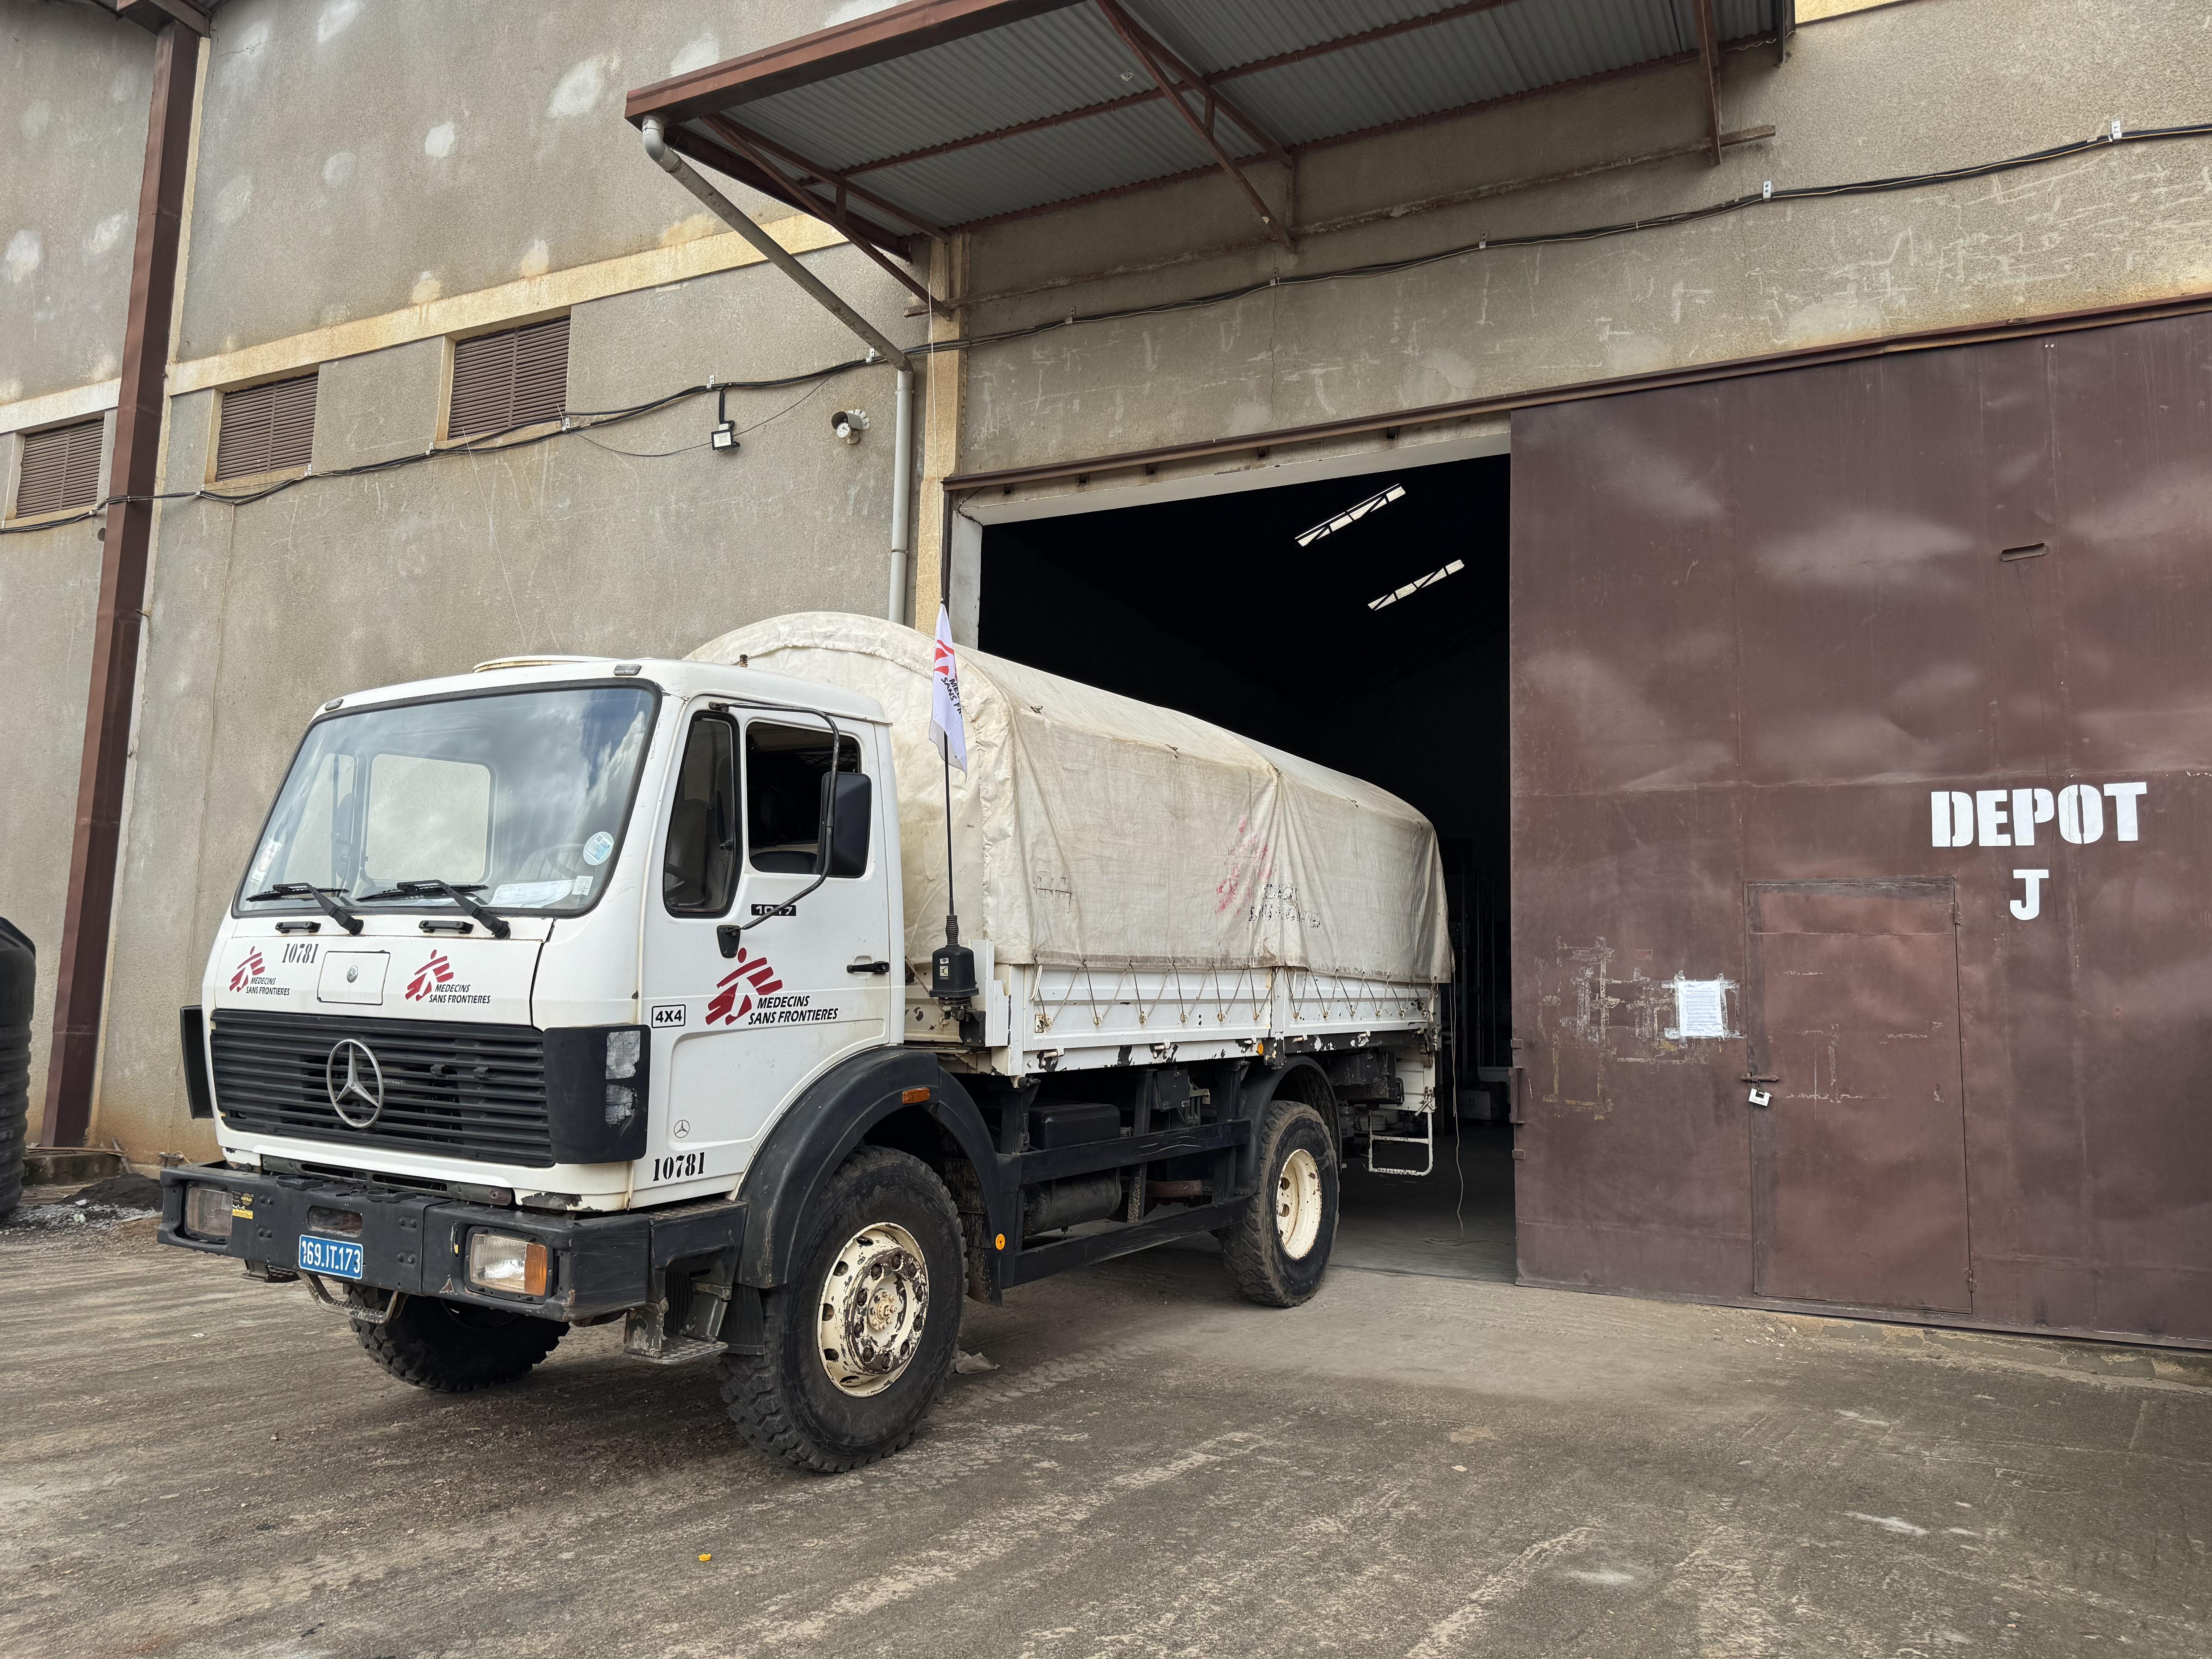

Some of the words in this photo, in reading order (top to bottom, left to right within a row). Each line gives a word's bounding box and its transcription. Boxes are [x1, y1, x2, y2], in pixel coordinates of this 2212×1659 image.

[941, 677, 957, 701] SANS
[1931, 782, 2147, 847] DEPOT
[2010, 869, 2049, 921] J
[282, 943, 319, 963] 10781
[250, 977, 276, 985] MEDECINS
[434, 984, 471, 992] MEDECINS
[259, 987, 290, 996] FRONTIERES
[429, 994, 446, 1003] SANS
[448, 994, 491, 1004] FRONTIERES
[757, 995, 810, 1009] MEDECINS
[655, 1010, 682, 1023] 4X4
[748, 1012, 776, 1025] SANS
[778, 1008, 838, 1023] FRONTIERES
[653, 1152, 704, 1182] 10781
